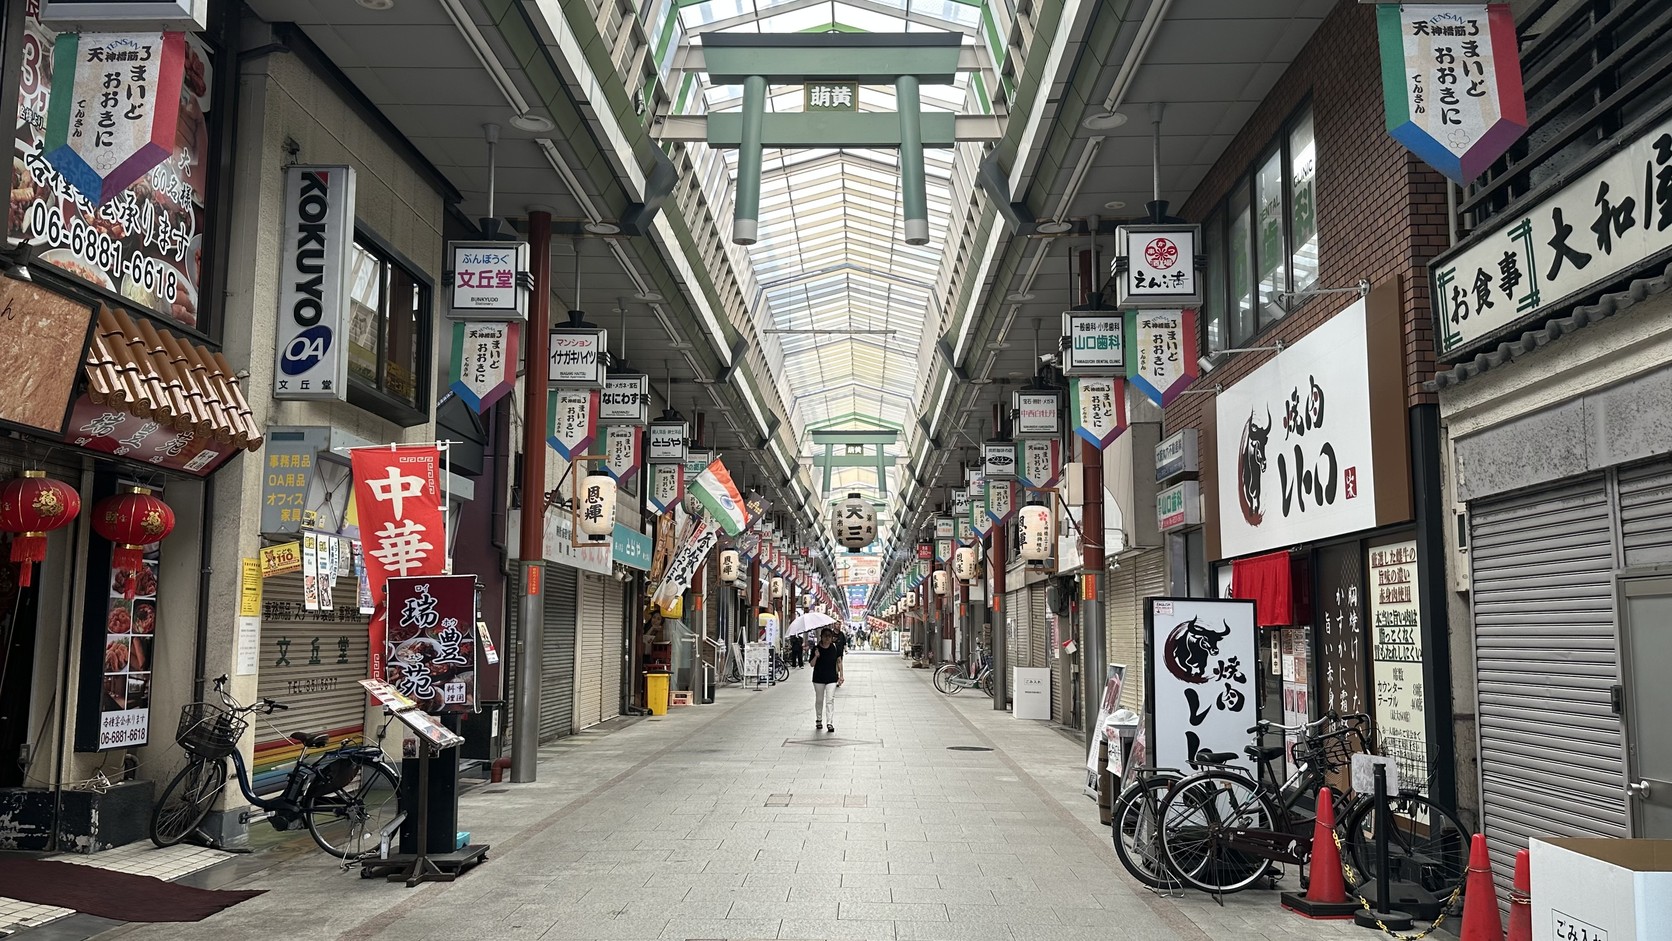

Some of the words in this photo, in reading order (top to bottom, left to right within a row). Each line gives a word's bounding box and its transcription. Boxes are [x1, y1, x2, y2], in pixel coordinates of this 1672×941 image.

[1412, 19, 1480, 37] 天神橋筋3
[1429, 12, 1465, 25] TENSAN
[86, 46, 152, 62] 天神橋筋3
[105, 38, 142, 51] TENSAN
[1460, 40, 1487, 98] まいど
[124, 64, 146, 121] まいど
[810, 85, 852, 108] 萌黄
[1411, 74, 1425, 114] てんさん
[1434, 46, 1462, 125] おおきに
[72, 100, 87, 138] てんさん
[94, 71, 121, 147] おおきに
[152, 167, 192, 211] 60名様
[31, 200, 177, 303] 06-6881-6618
[293, 171, 329, 326] KOKUYO
[462, 254, 510, 264] ぶんぼうぐ
[457, 270, 513, 289] 文丘堂
[1450, 251, 1522, 325] お食事
[1142, 319, 1177, 329] 天神橋筋3
[285, 337, 324, 361] OA
[556, 338, 592, 347] マンション
[1074, 335, 1120, 350] 山口歯科
[1166, 330, 1178, 362] まいど
[474, 344, 487, 383] おおきに
[489, 340, 500, 369] まいど
[551, 350, 596, 366] イナガキハイツ
[1153, 334, 1165, 377] おおきに
[279, 380, 332, 390] 文丘堂
[602, 392, 639, 404] なにわず
[1102, 394, 1112, 417] まいど
[1283, 374, 1325, 441] 焼肉
[565, 406, 576, 439] おおきに
[577, 404, 586, 428] まいど
[1091, 395, 1102, 428] おおきに
[652, 438, 681, 448] とらや
[269, 454, 311, 468] 事務用品
[268, 473, 305, 487] OA用品
[266, 493, 304, 505] オフィス
[280, 508, 301, 522] 家具
[364, 466, 434, 576] 中華
[846, 504, 864, 541] 天三
[276, 553, 294, 563] 110
[1379, 585, 1411, 603] 赤身肉使用
[275, 636, 350, 666] 文丘堂
[1213, 655, 1247, 712] 焼肉
[1377, 680, 1403, 694] カウンター
[1377, 693, 1399, 708] テーブル
[101, 727, 146, 745] 06-6881-6618
